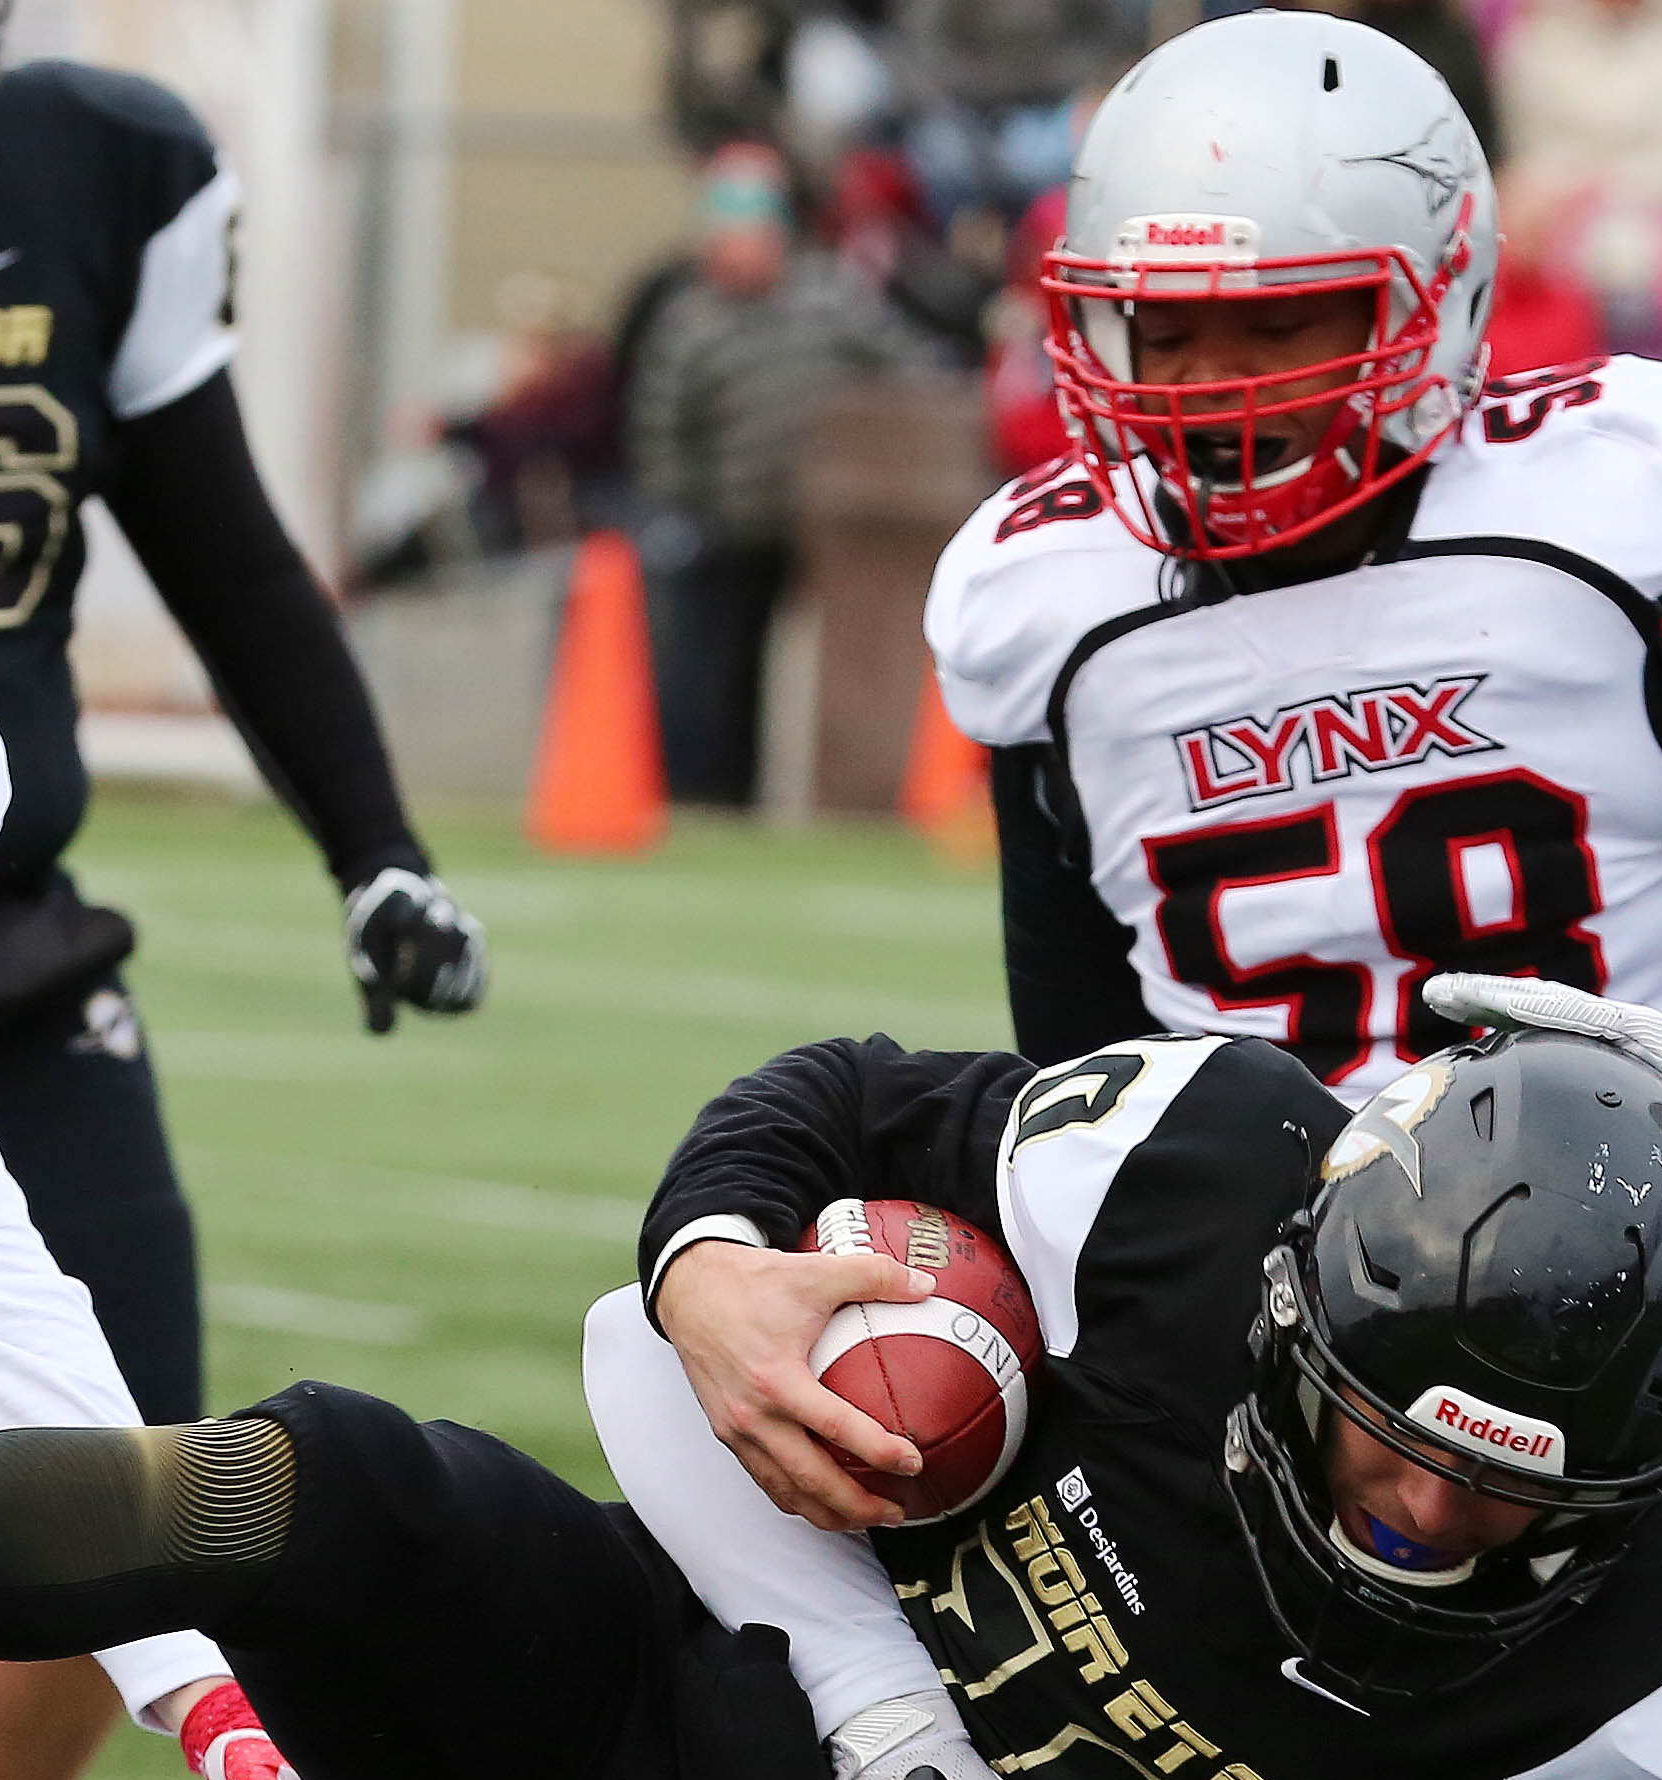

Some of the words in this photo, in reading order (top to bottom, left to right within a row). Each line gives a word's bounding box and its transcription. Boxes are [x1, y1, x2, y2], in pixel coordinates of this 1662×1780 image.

[1172, 673, 1506, 813] LYNX
[1140, 765, 1610, 1087] 58
[1435, 1397, 1555, 1459] Riddell
[1078, 1506, 1146, 1616] Desjardins
